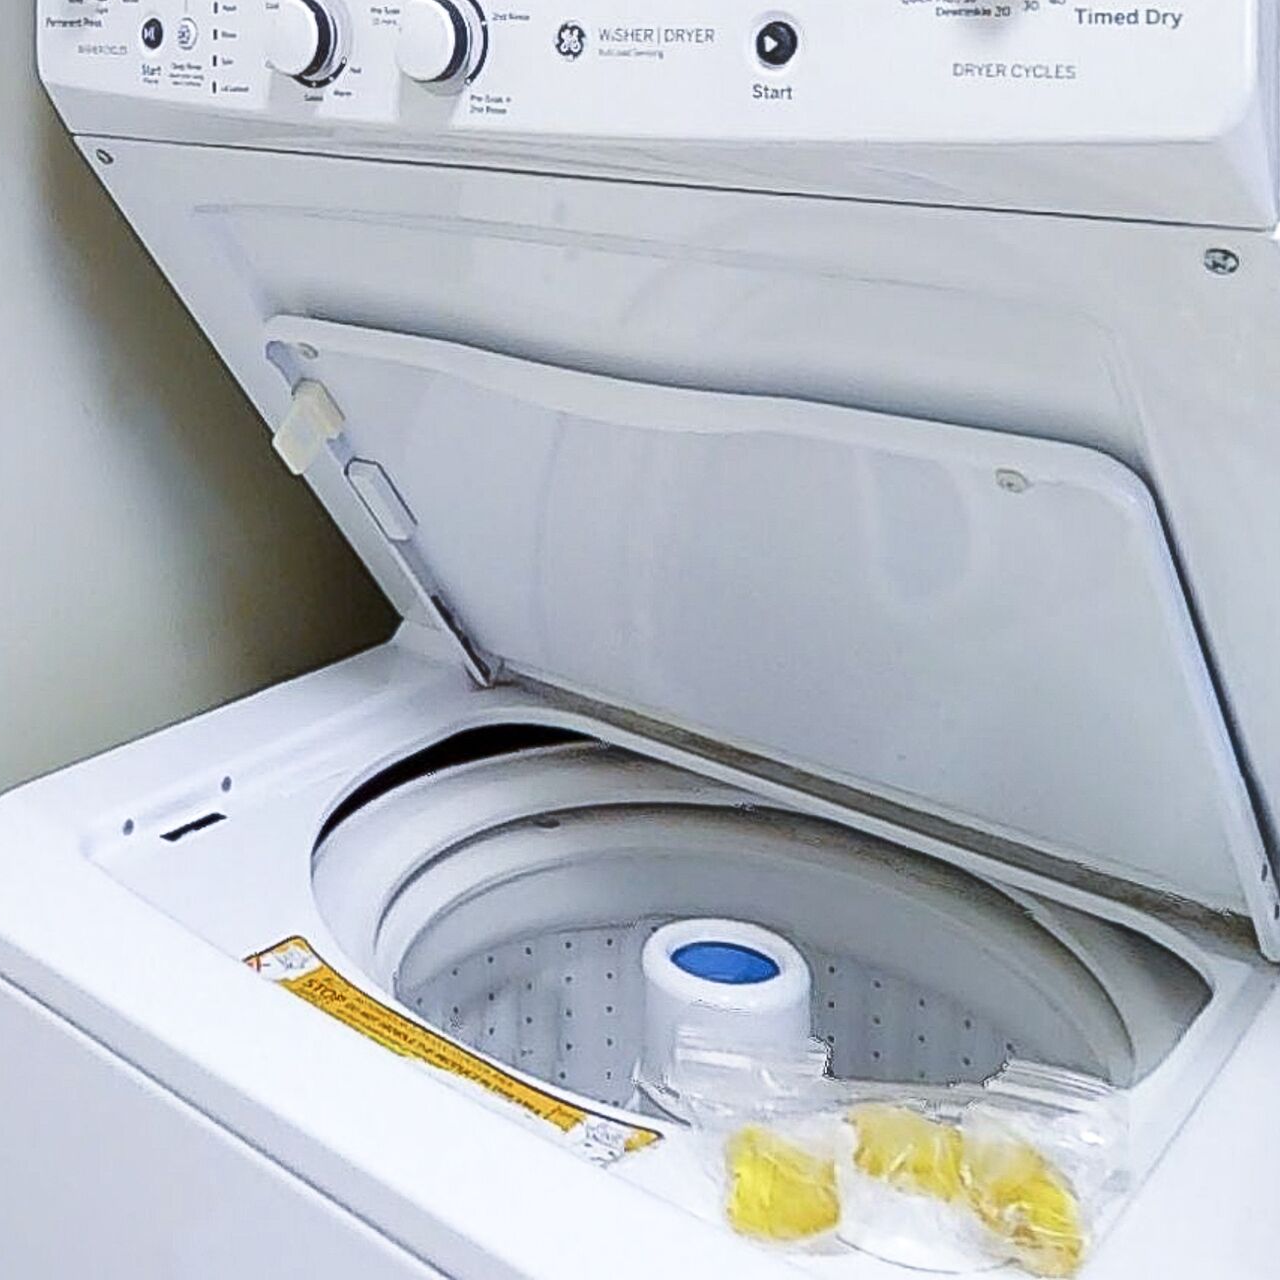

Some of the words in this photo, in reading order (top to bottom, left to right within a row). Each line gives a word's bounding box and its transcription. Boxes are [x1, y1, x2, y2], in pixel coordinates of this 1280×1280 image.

[1074, 8, 1139, 25] Timed
[1146, 8, 1183, 29] Dry
[663, 28, 716, 43] DRYER
[952, 62, 1008, 79] DRYER
[1010, 64, 1077, 80] CYCLES
[752, 84, 793, 100] Start
